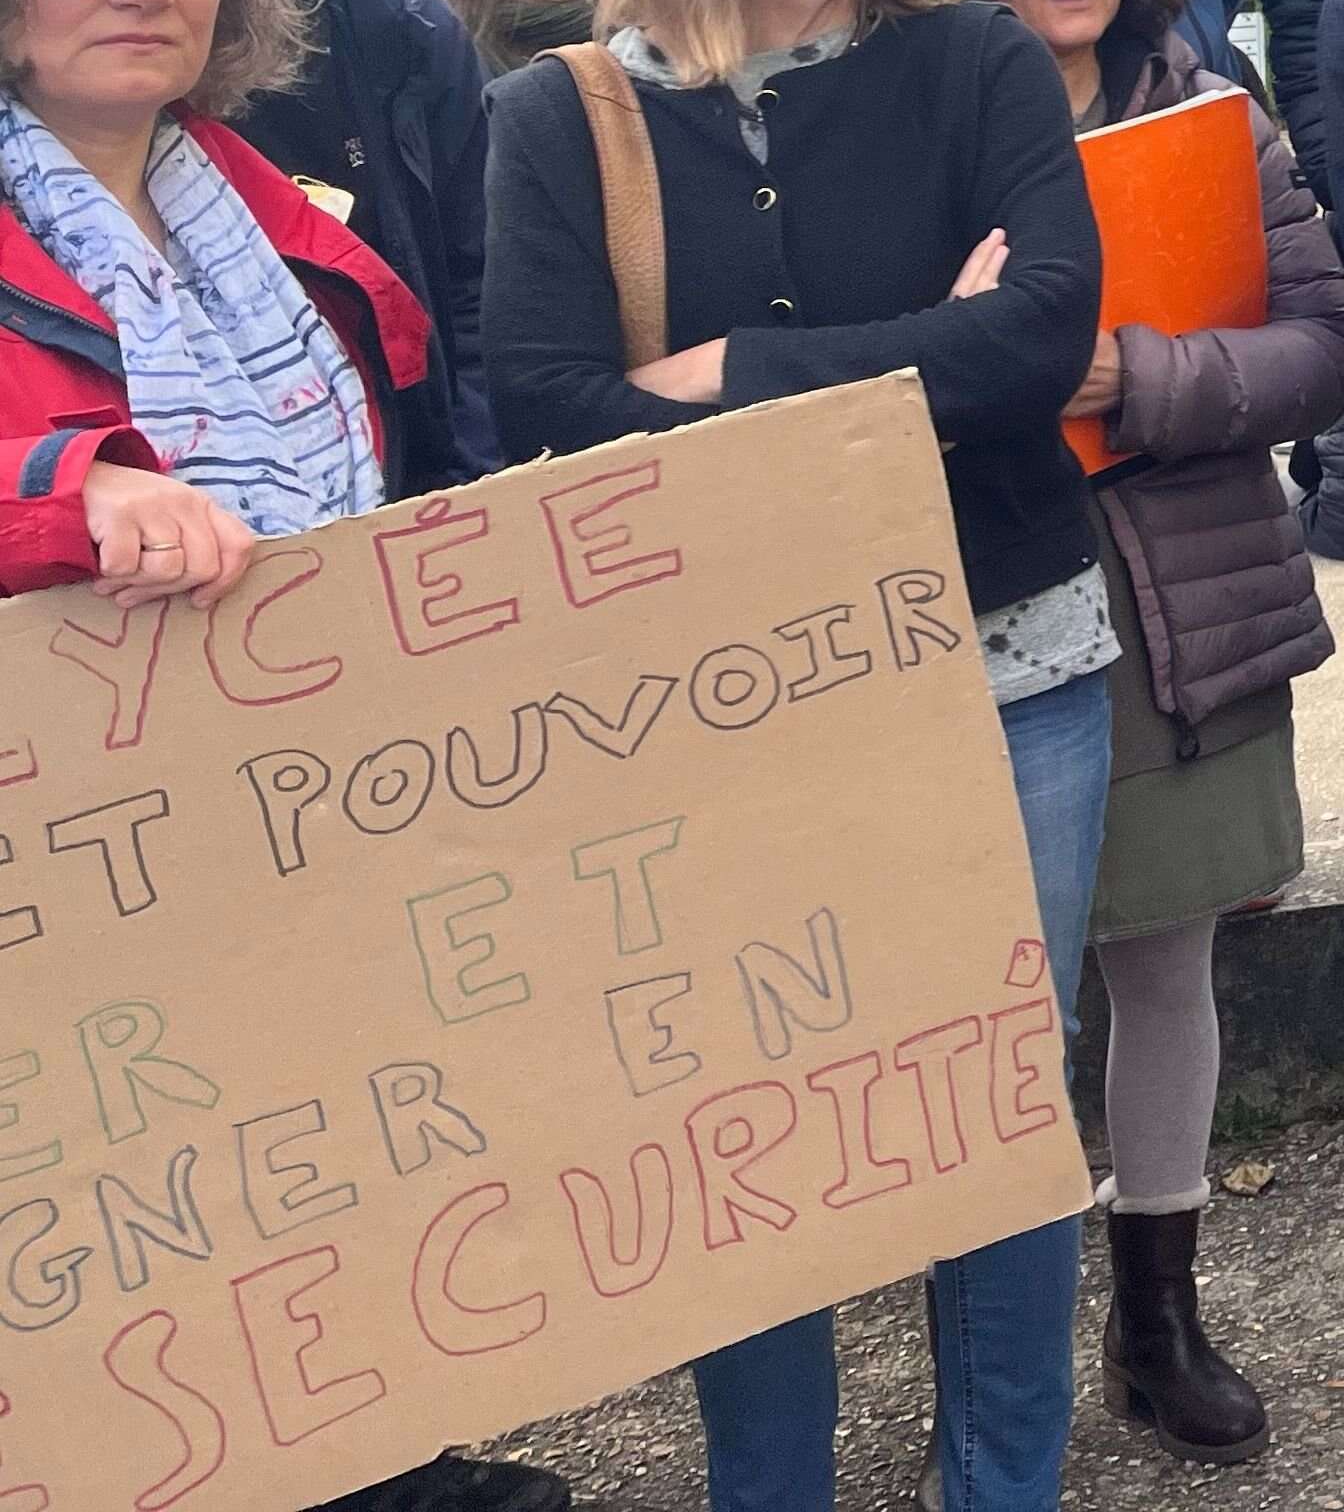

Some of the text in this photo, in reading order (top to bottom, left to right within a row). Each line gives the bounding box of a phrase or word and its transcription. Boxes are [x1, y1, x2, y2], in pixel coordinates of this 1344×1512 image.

[237, 569, 962, 876] POUVOIR
[405, 814, 685, 1024] ET
[603, 906, 855, 1098] EN
